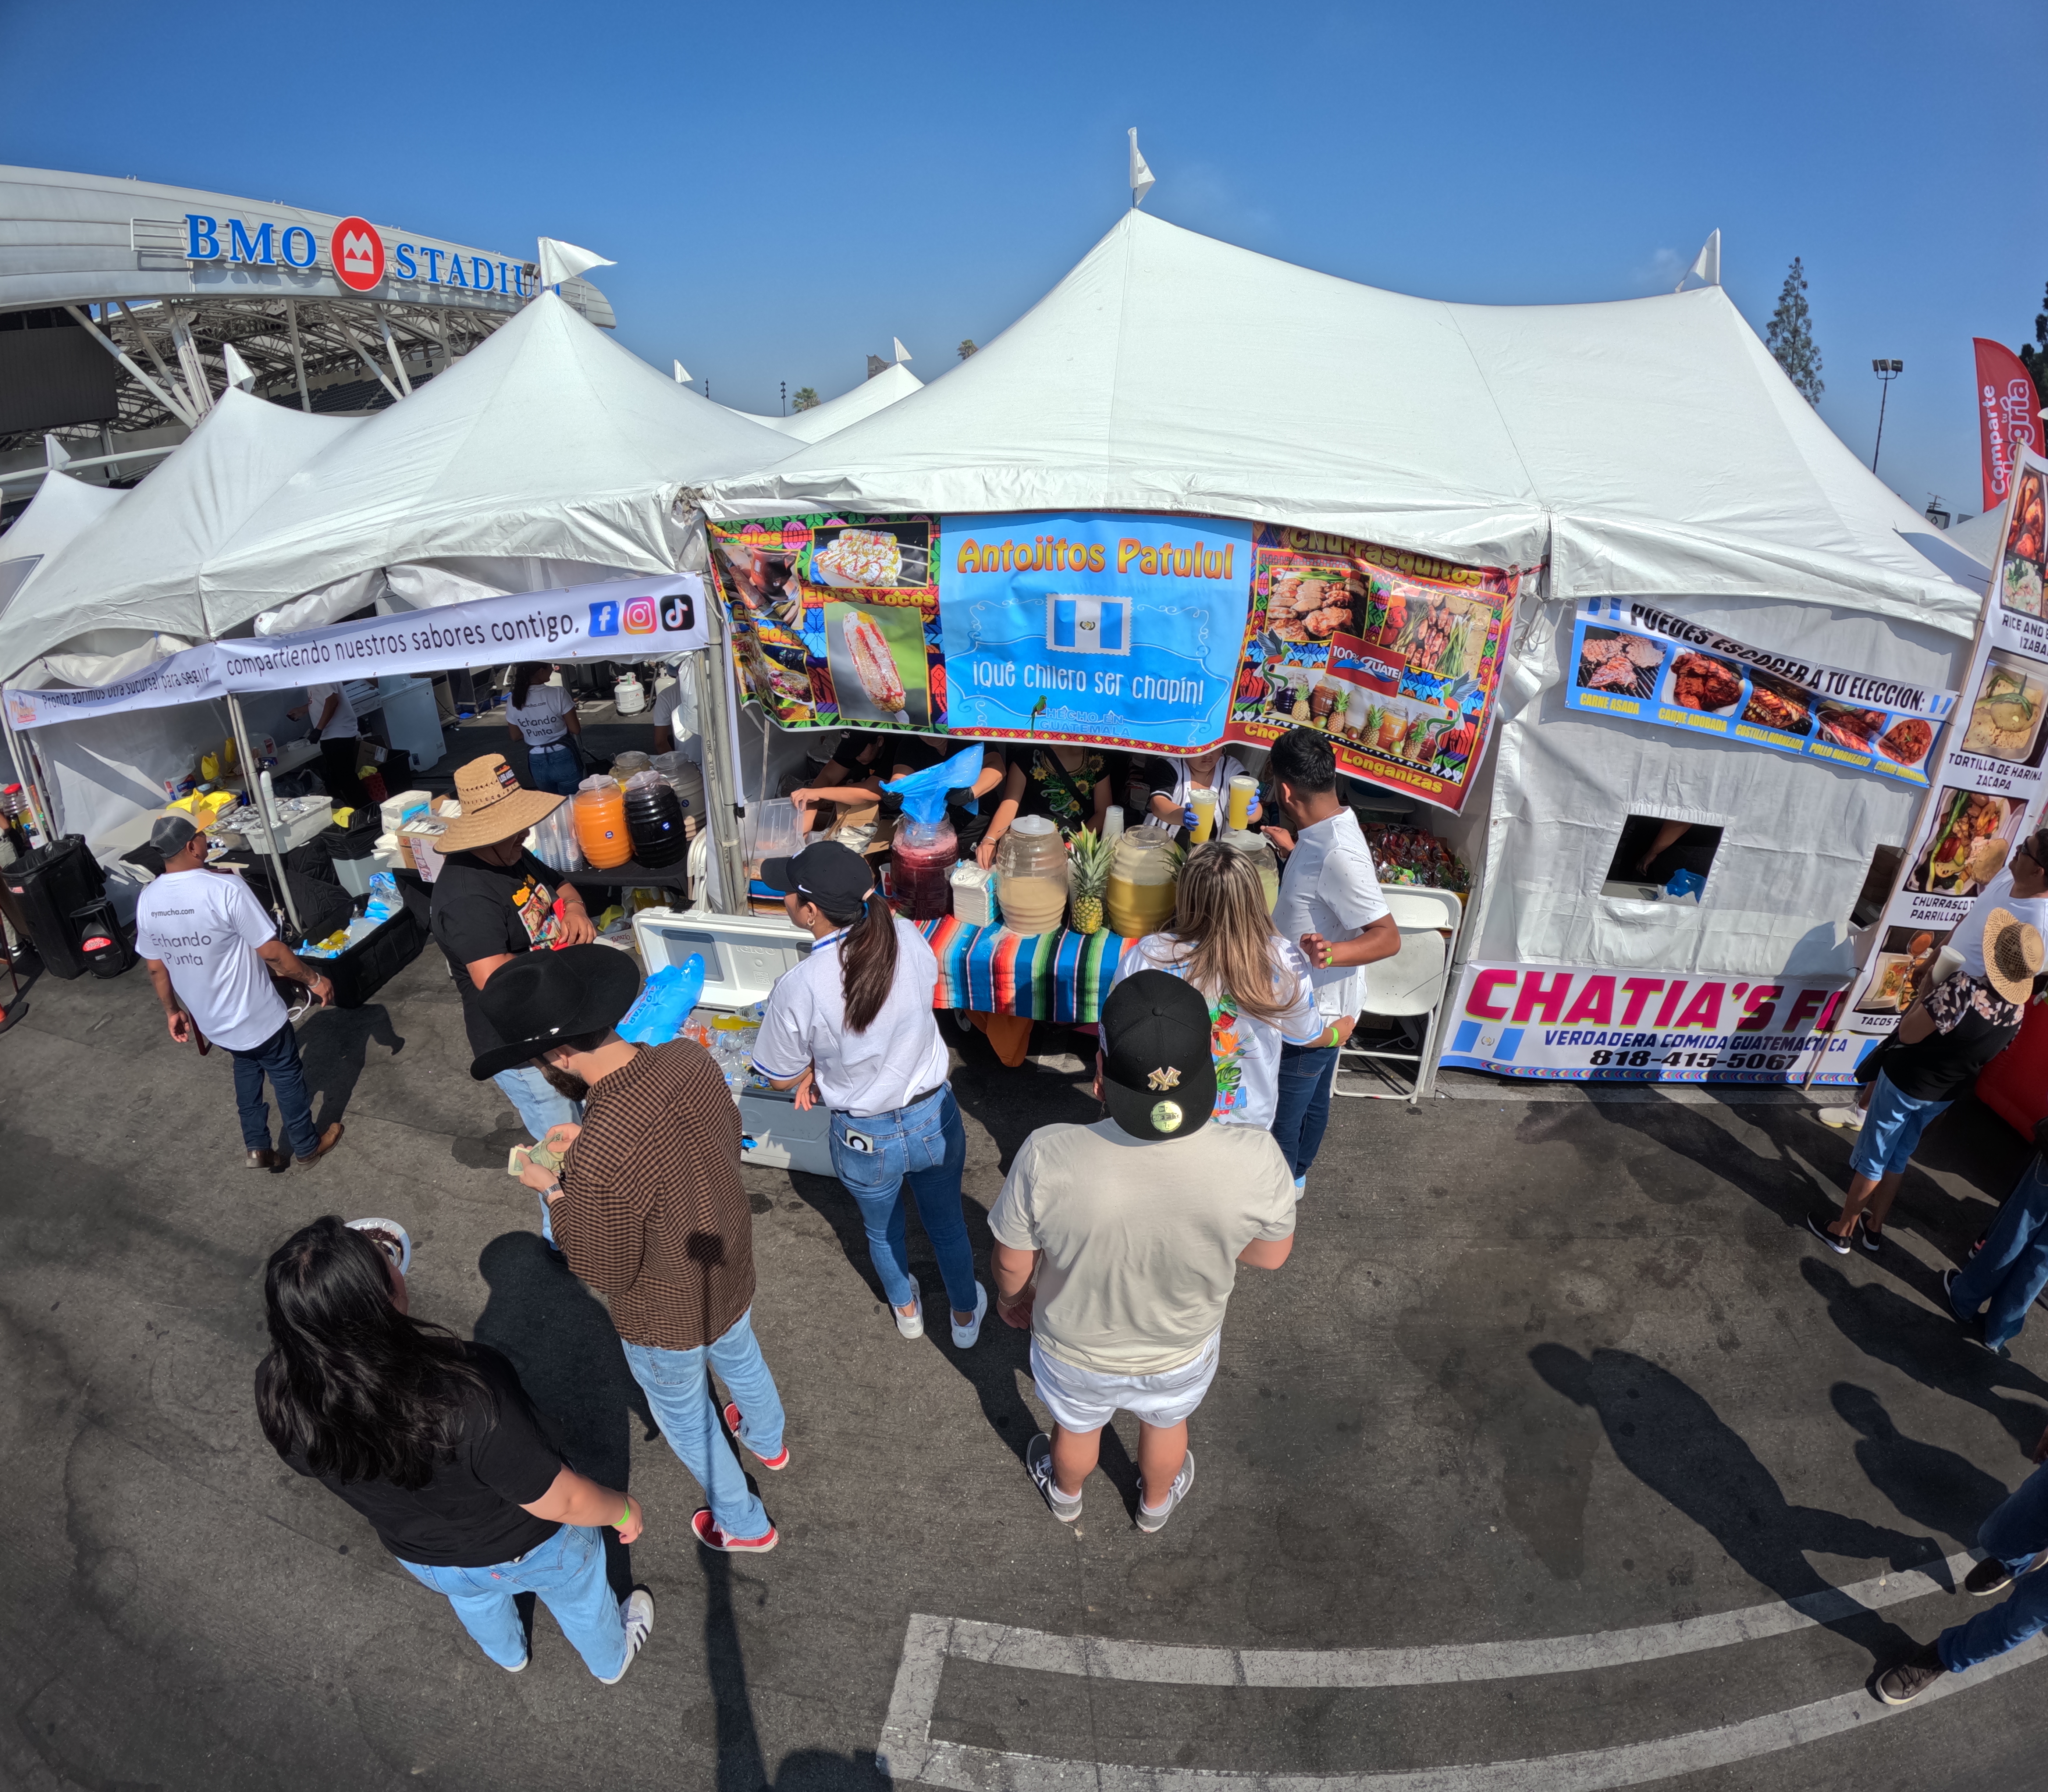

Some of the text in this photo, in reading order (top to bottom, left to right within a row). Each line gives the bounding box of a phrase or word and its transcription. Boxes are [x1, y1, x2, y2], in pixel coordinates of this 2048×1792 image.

[185, 214, 561, 299] BMO STADIU
[2001, 413, 2008, 423] tu
[1982, 385, 2006, 495] Comparte
[957, 535, 1234, 579] Antojitos Patulul
[1290, 527, 1483, 586] Churrasquitos
[803, 587, 936, 607] Elotes Locos
[2002, 613, 2022, 631] RICE
[2023, 622, 2044, 637] AND
[227, 611, 579, 678] compartiendo nuestros sabores contigo.
[1631, 602, 1714, 645] PUEDES
[1806, 669, 1824, 689] A
[1825, 671, 1850, 695] TU
[1333, 646, 1402, 682] 100% GUATE!
[41, 694, 70, 710] Pronto
[126, 671, 161, 695] sucursal
[161, 673, 182, 693] para
[181, 663, 210, 688] seguir
[972, 660, 1205, 705] ¡Qué chilero ser chapín!
[1579, 693, 1640, 715] CARNE ASADA
[518, 715, 557, 728] Echando
[1045, 707, 1124, 725] HECHO EN
[1658, 707, 1728, 732] CARNE ADOBADA
[526, 728, 553, 737] Punta
[1038, 719, 1131, 738] GUATEMALA
[1735, 724, 1768, 742] COSTILLA
[1808, 743, 1833, 758] POLLO
[1341, 748, 1443, 794] Longanizas
[1949, 753, 2042, 781] TORTILLA DE HARINA
[1976, 775, 2012, 790] ZACAPA
[151, 908, 195, 917] eymucha.com
[1912, 896, 1968, 910] CHURRASCO
[1910, 909, 1964, 922] PARRILLAD
[151, 931, 212, 948] Echando
[164, 952, 204, 966] Punta
[1465, 968, 1784, 1034] CHATIA'S
[629, 1003, 647, 1024] STAR
[1860, 1016, 1893, 1026] TACOS
[1545, 1030, 1657, 1048] VERDADERA
[1659, 1033, 1729, 1050] COMIDA
[1590, 1049, 1799, 1071] 818-415-5067
